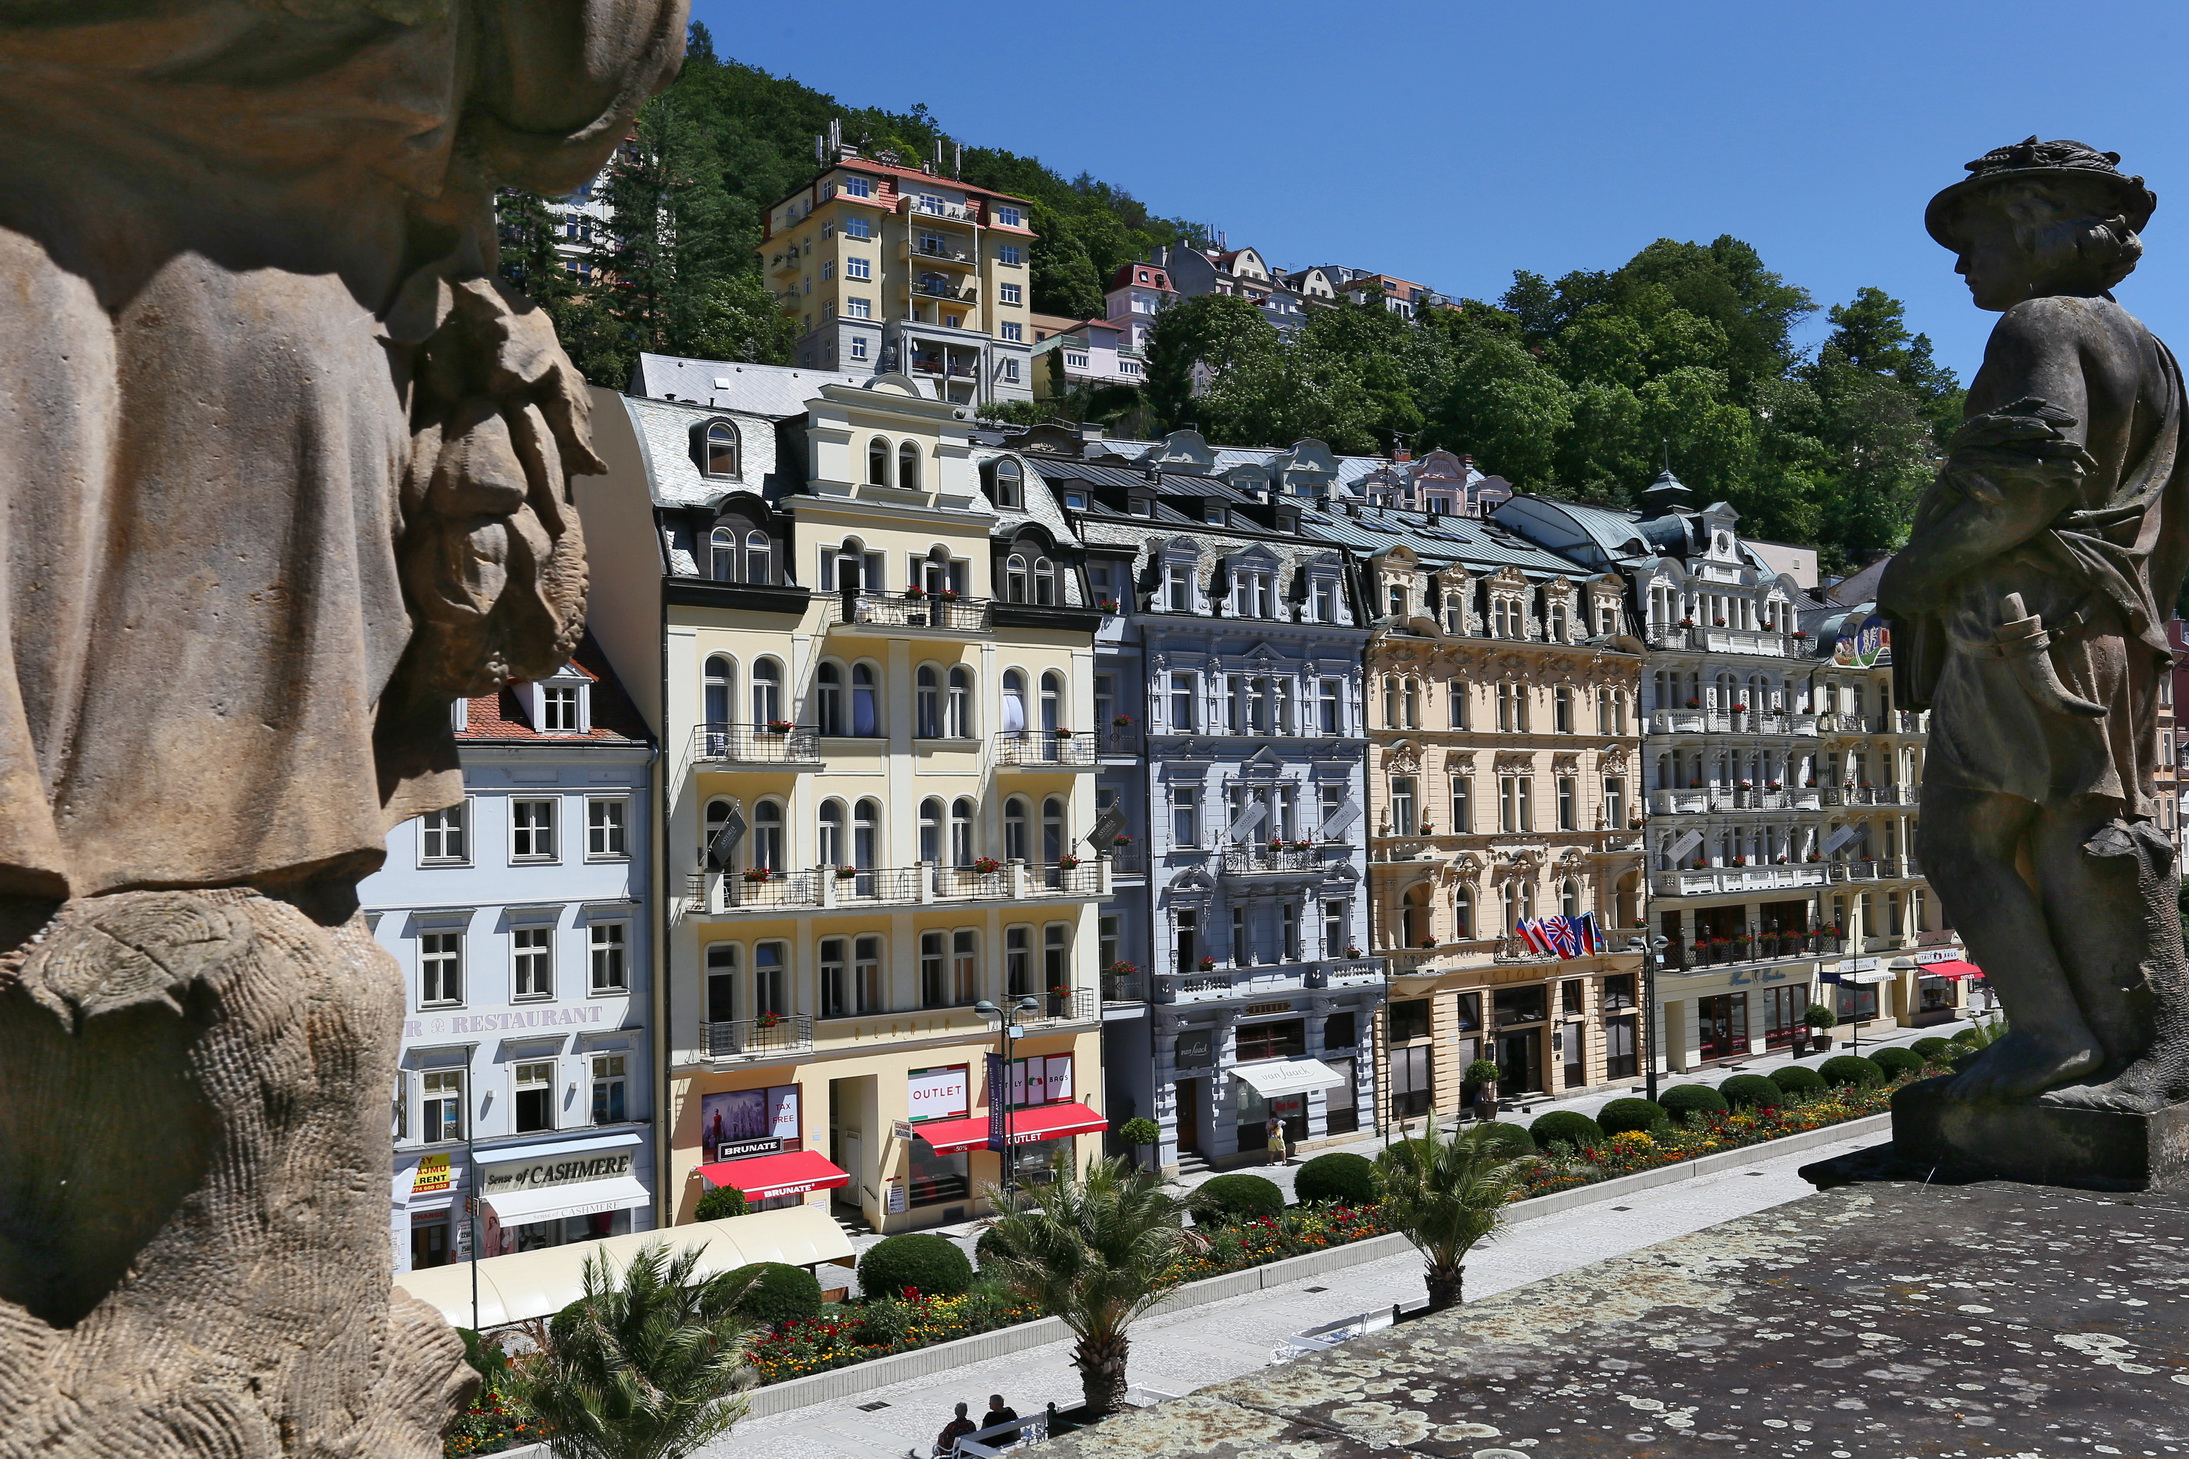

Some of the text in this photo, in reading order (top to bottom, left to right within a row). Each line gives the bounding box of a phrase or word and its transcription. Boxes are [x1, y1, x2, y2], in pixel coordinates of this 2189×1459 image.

[1478, 966, 1562, 985] ASTORIA
[451, 1006, 603, 1034] RESTAURANT
[1049, 1075, 1068, 1083] BAGS
[913, 1085, 962, 1100] OUTLET
[775, 1103, 791, 1111] TAX
[772, 1115, 794, 1124] FREE
[724, 1142, 778, 1156] BRUNATE
[487, 1155, 629, 1185] Sense of CASHMERE
[419, 1174, 447, 1185] RENT
[560, 1201, 620, 1217] CASHMERE
